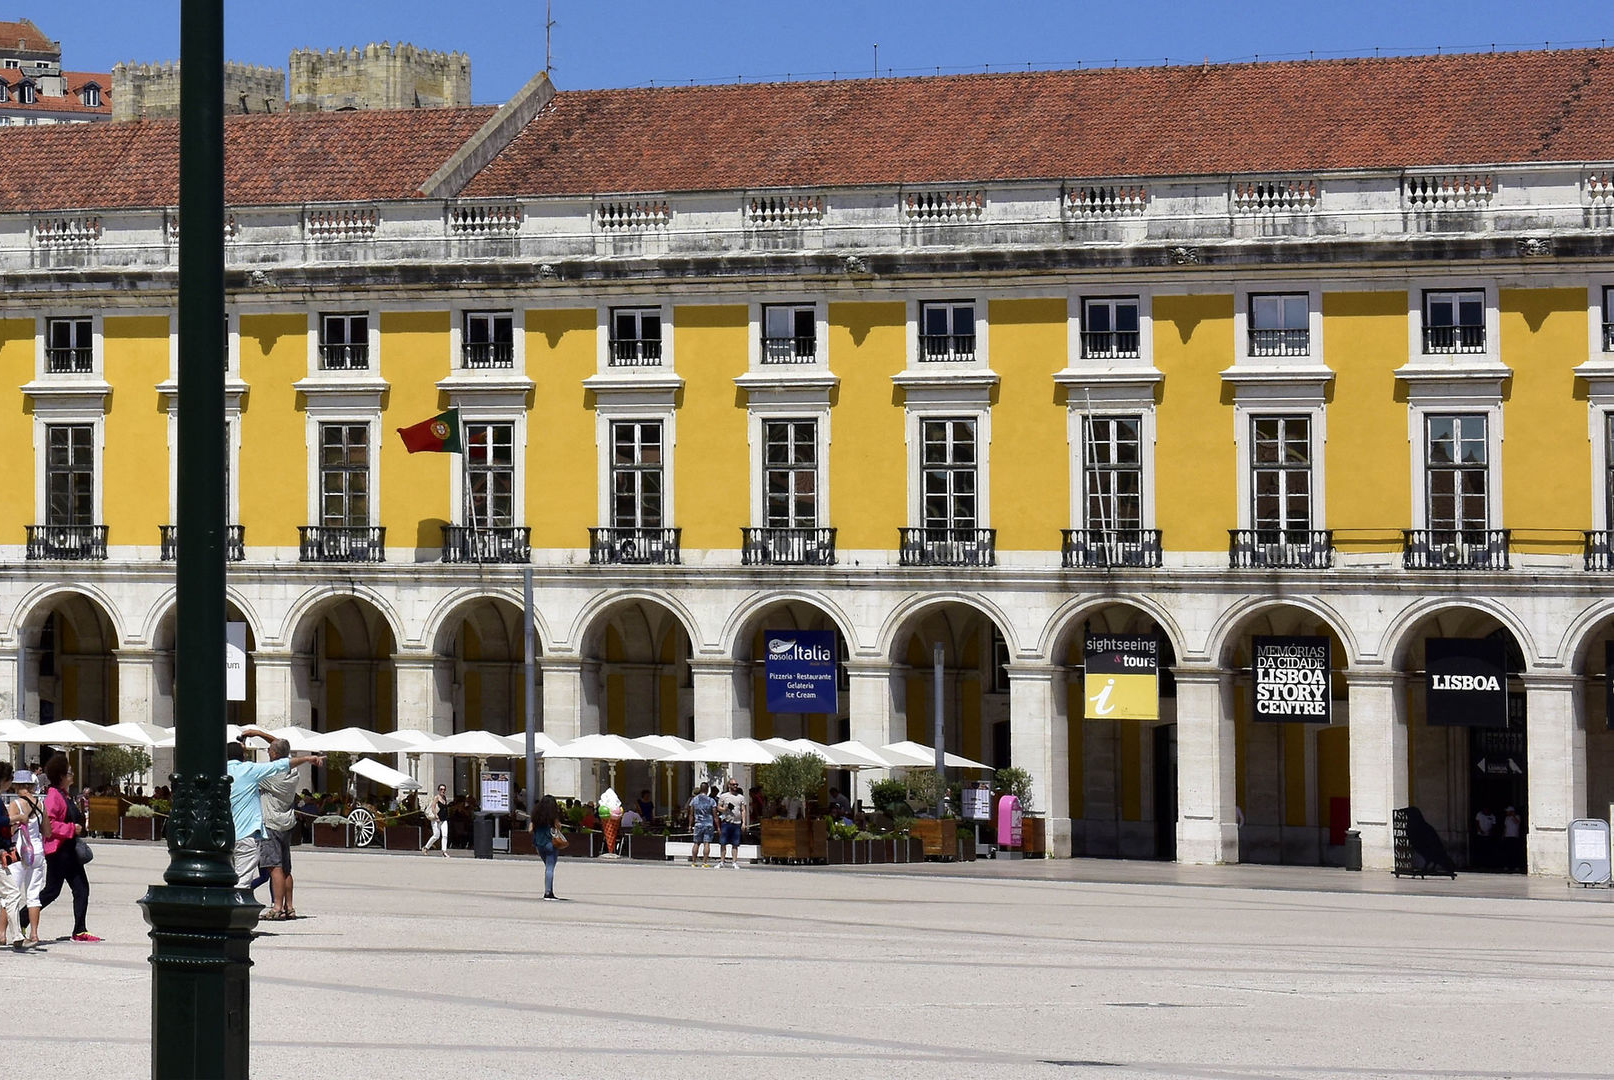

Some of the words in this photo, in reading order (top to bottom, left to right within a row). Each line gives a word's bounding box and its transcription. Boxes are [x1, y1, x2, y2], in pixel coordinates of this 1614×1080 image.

[794, 644, 831, 660] Italia
[1086, 636, 1156, 653] sightseeing
[1257, 643, 1325, 658] MEMÓRIAS
[1123, 654, 1156, 667] tours
[1257, 657, 1276, 668] DA
[1277, 657, 1325, 669] CIDADE
[769, 672, 793, 680] Pizzeria
[796, 672, 832, 680] Restaurante
[1257, 668, 1326, 685] LISBOA
[1432, 674, 1501, 691] LISBOA
[787, 681, 814, 689] Gelateria
[1256, 683, 1326, 701] STORY
[785, 691, 795, 699] Ice
[796, 691, 817, 699] Cream
[1256, 699, 1326, 716] CENTRE
